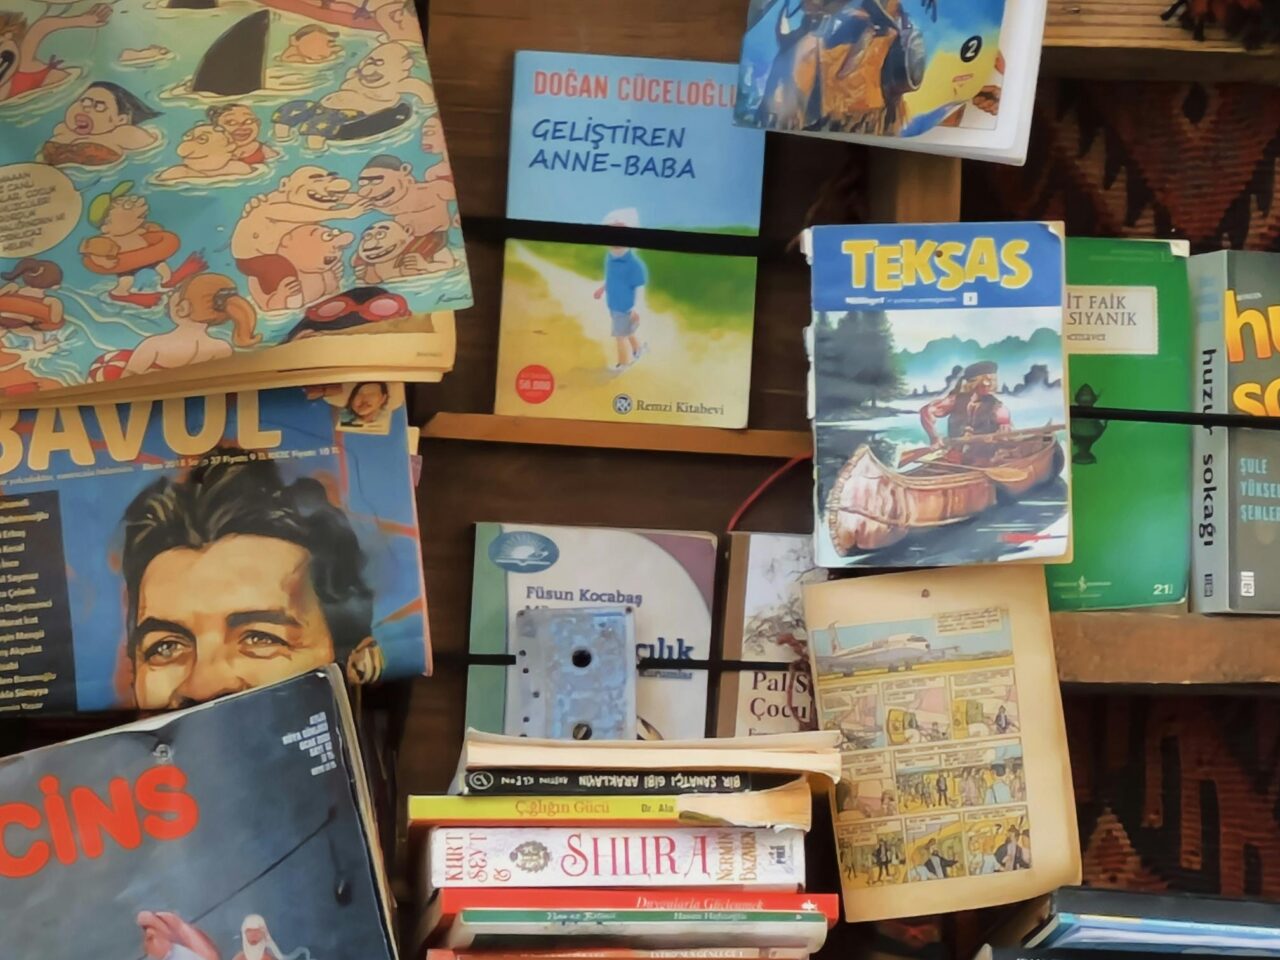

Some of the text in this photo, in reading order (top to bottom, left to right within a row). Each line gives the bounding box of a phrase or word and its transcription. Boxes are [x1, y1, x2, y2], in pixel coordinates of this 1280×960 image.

[534, 68, 738, 107] DOĞAN CÜCELOĞLU
[532, 117, 685, 149] GELİŞTİREN
[529, 150, 696, 179] ANNE-BABA
[842, 237, 1033, 291] TEKSAS
[1089, 293, 1126, 309] FAİK
[636, 400, 724, 415] Remzi Kitabevi
[1199, 349, 1217, 546] huzur sokağı
[1239, 458, 1268, 475] ŞULE
[526, 587, 643, 604] Füsun Kocabaş
[752, 672, 787, 691] Pal
[579, 773, 740, 788] BİR SANATÇI GİBİ ARAKLAYIN
[574, 802, 609, 814] Gücü
[641, 804, 654, 812] Dr.
[0, 765, 199, 879] CİNS
[560, 833, 711, 877] SHURA
